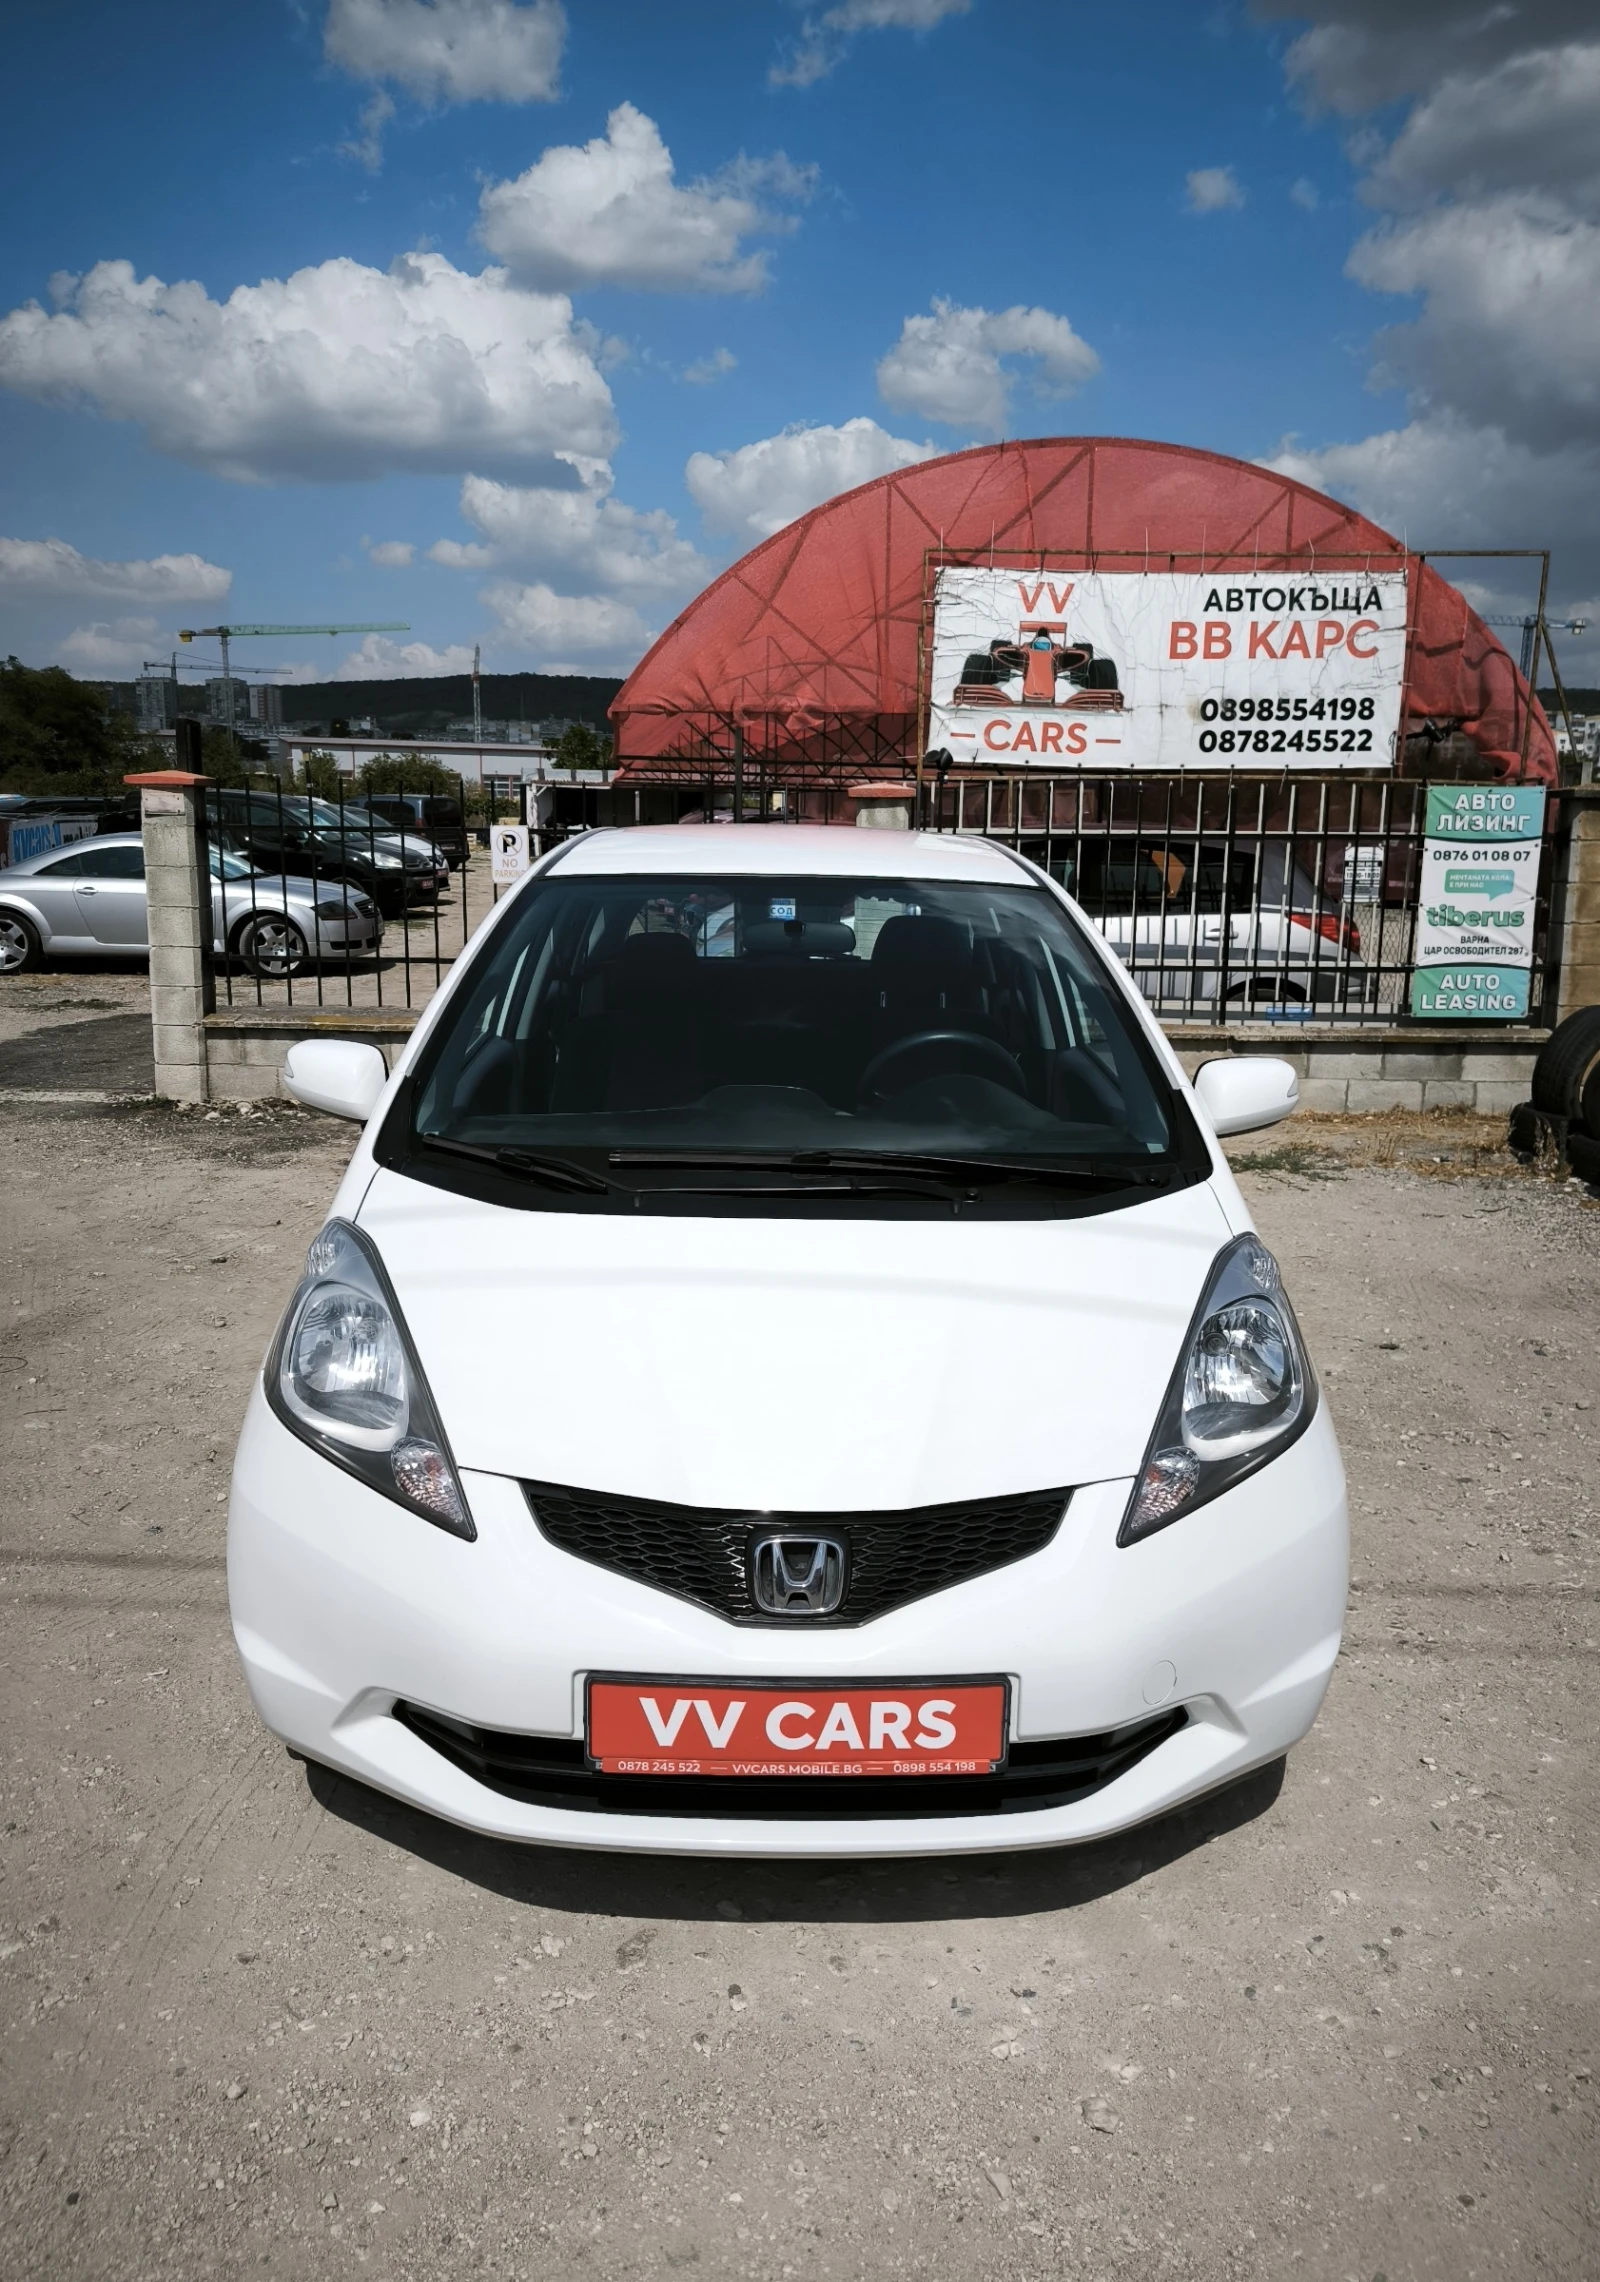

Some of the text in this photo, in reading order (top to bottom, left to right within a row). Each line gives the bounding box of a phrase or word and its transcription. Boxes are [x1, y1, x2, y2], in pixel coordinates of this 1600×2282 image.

[1017, 582, 1075, 614] VV
[1203, 585, 1383, 615] АВТОКЪЩА
[1169, 619, 1381, 660] ВВ КАРС
[1200, 697, 1376, 723] 0898554198
[983, 720, 1088, 754] CARS
[1199, 728, 1373, 753] 0878245522
[1454, 793, 1516, 811] АВТО
[1436, 814, 1531, 832] ЛИЗИНГ
[502, 858, 518, 868] NO
[1433, 850, 1531, 861] 0876 01 08 07
[1426, 904, 1525, 927] tiberus
[1460, 936, 1489, 944] ВАРНА
[1424, 946, 1441, 955] ЦАР
[1444, 946, 1506, 955] ОСВОБОДИТЕЛ
[1439, 974, 1500, 991] AUTO
[1420, 994, 1516, 1011] LEASING
[638, 1696, 957, 1751] VV CARS
[618, 1761, 976, 1775] 0878 245 522 VVCARS.MOBILE.BG 0898 554 198
